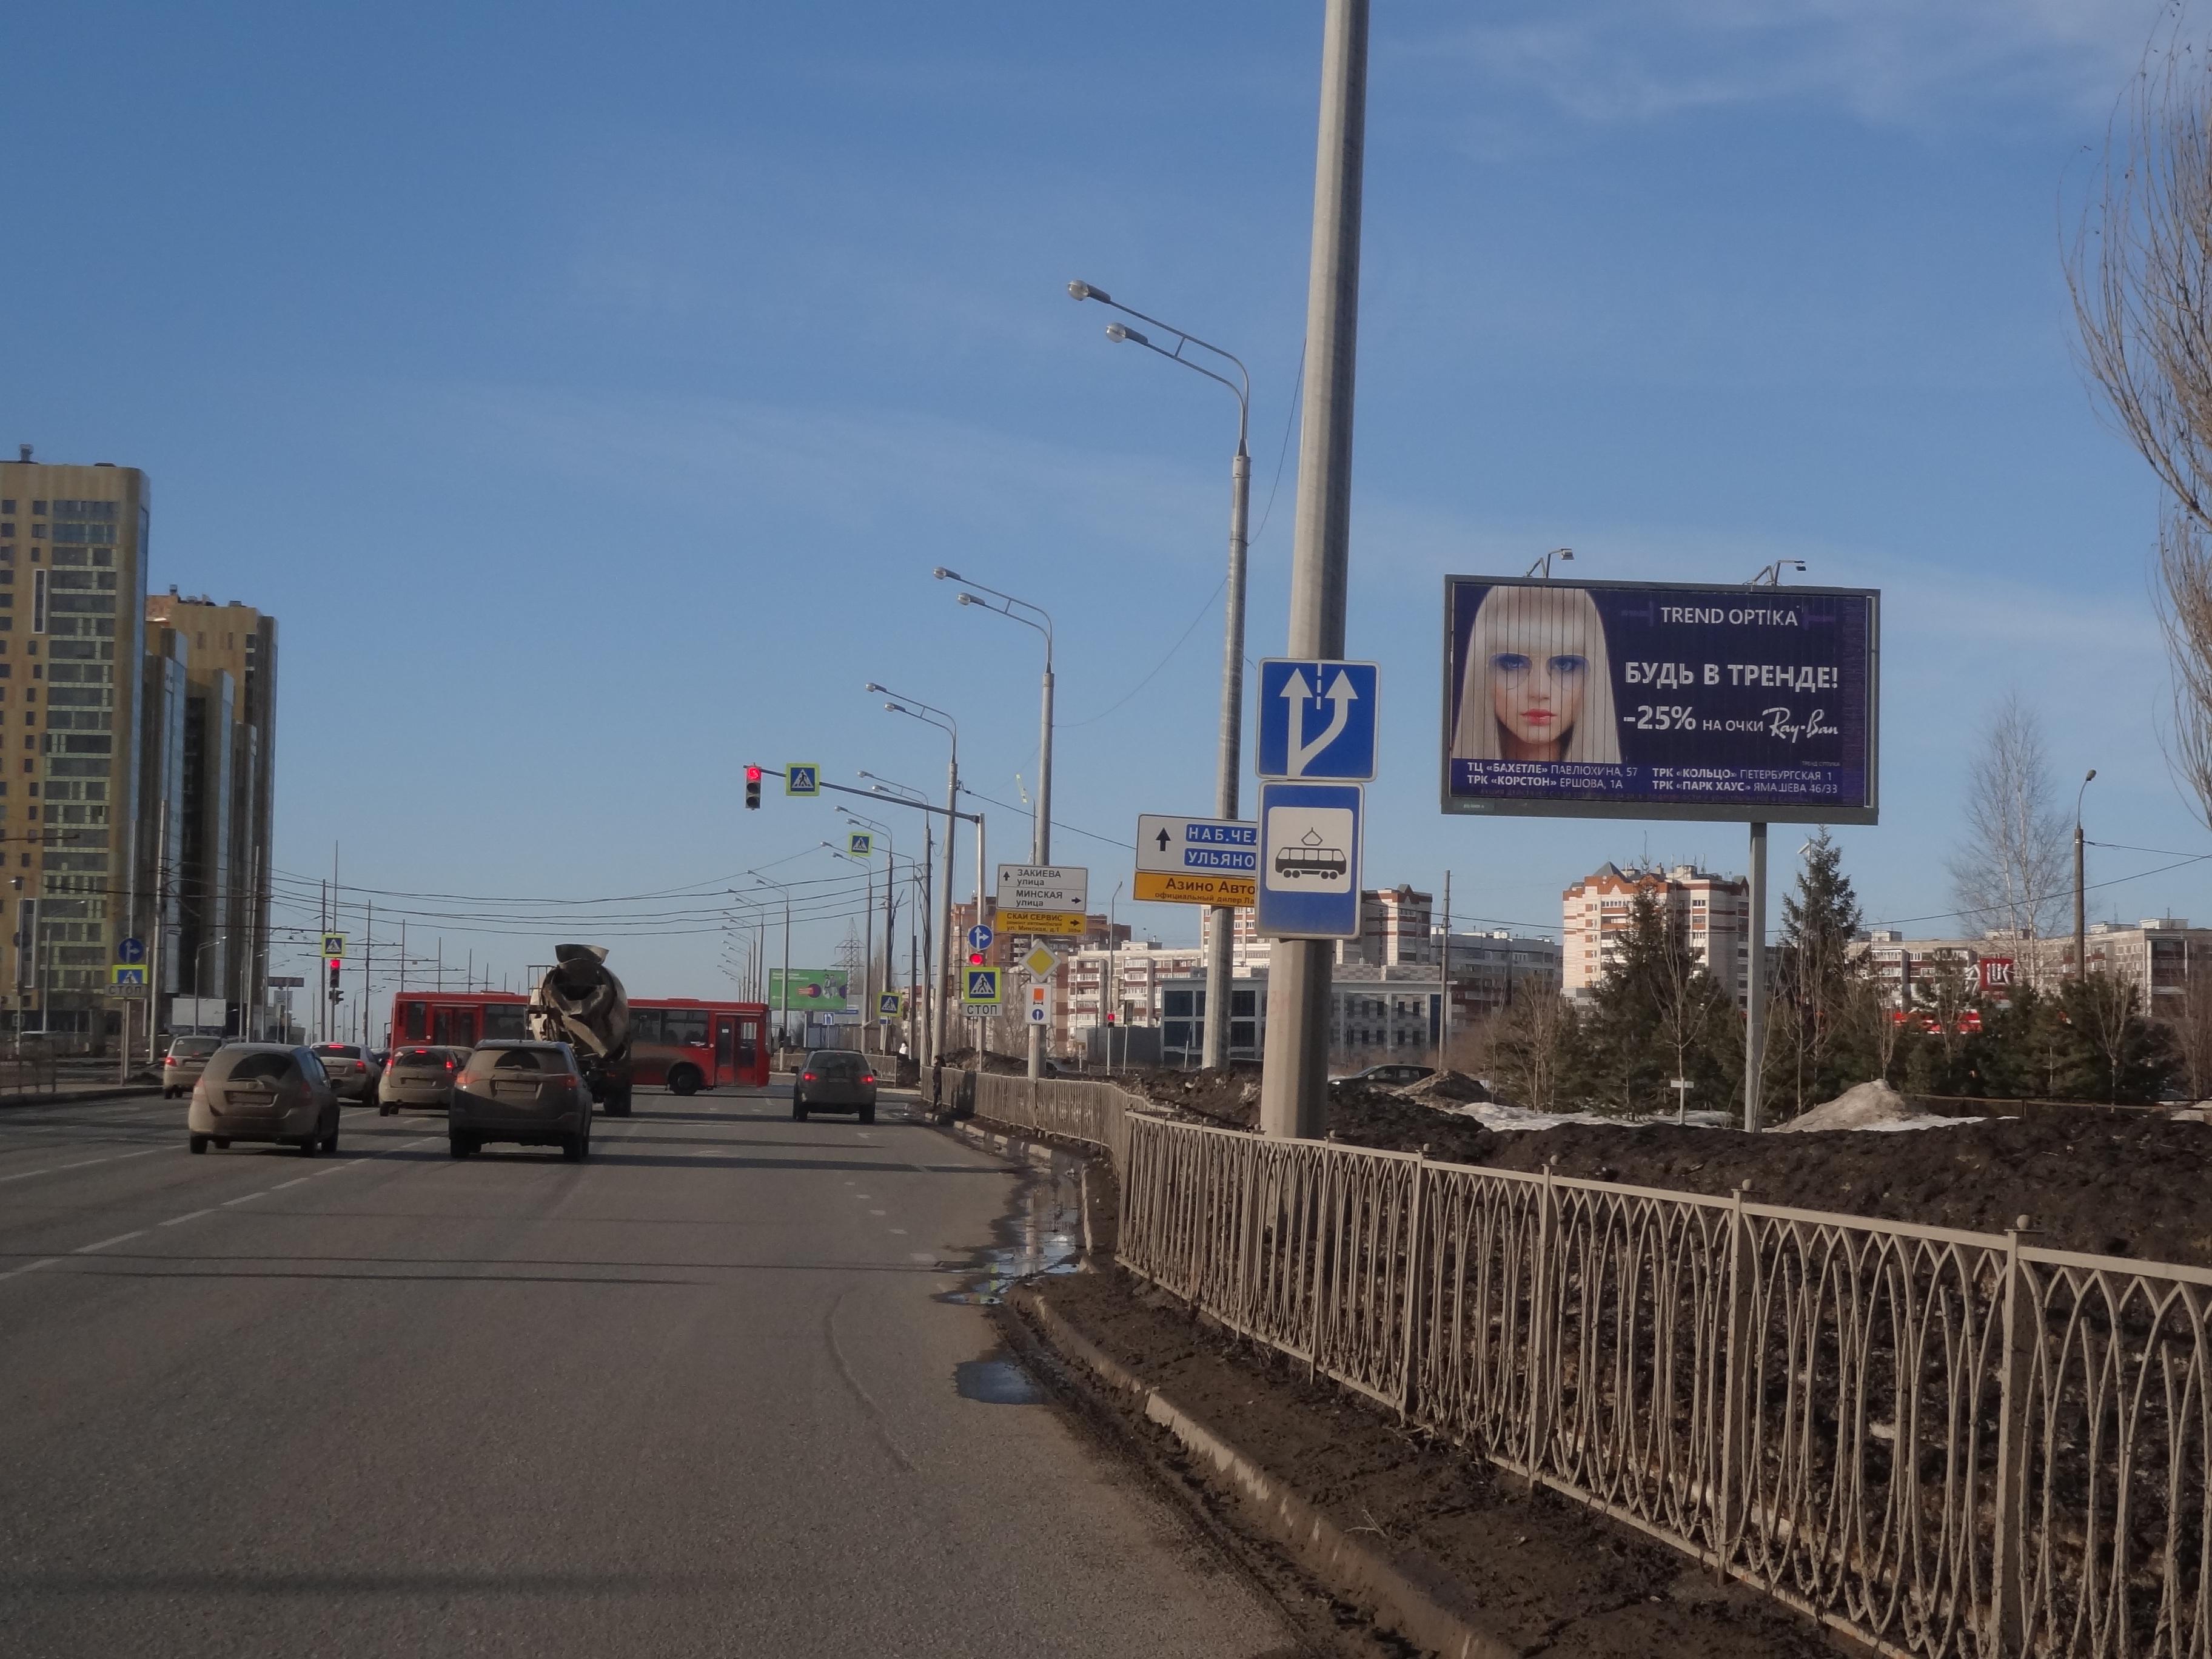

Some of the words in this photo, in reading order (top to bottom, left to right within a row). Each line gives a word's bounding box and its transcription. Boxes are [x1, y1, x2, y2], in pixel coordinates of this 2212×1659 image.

[1660, 607, 1724, 624] TREND
[1729, 608, 1798, 626] OPTIKA
[1625, 662, 1694, 689] БУДЬ
[1704, 663, 1720, 685] В
[1727, 664, 1838, 693] ТРЕНДЕ!
[1623, 705, 1697, 730] -25%
[1703, 719, 1721, 731] НА
[1726, 720, 1763, 732] ОЧКИ
[1467, 762, 1483, 773] ТЦ
[1626, 767, 1638, 776] 57
[1652, 768, 1674, 777] ТРК
[1467, 775, 1488, 785] ТРК
[1560, 778, 1606, 789] ЕРШОВА,
[1652, 780, 1674, 789] ТРК
[1809, 783, 1838, 794] 46/33
[1188, 827, 1256, 843] НАБ.ЧЕ
[1017, 869, 1061, 878] ЗАКИЕВА
[1165, 877, 1213, 893] Азино
[1218, 881, 1255, 895] Авто
[1016, 890, 1062, 899] МИНСКАЯ
[1155, 891, 1213, 902] официальный
[1217, 896, 1242, 905] дилер
[109, 985, 142, 995] СТОП
[967, 1005, 997, 1014] СТОП
